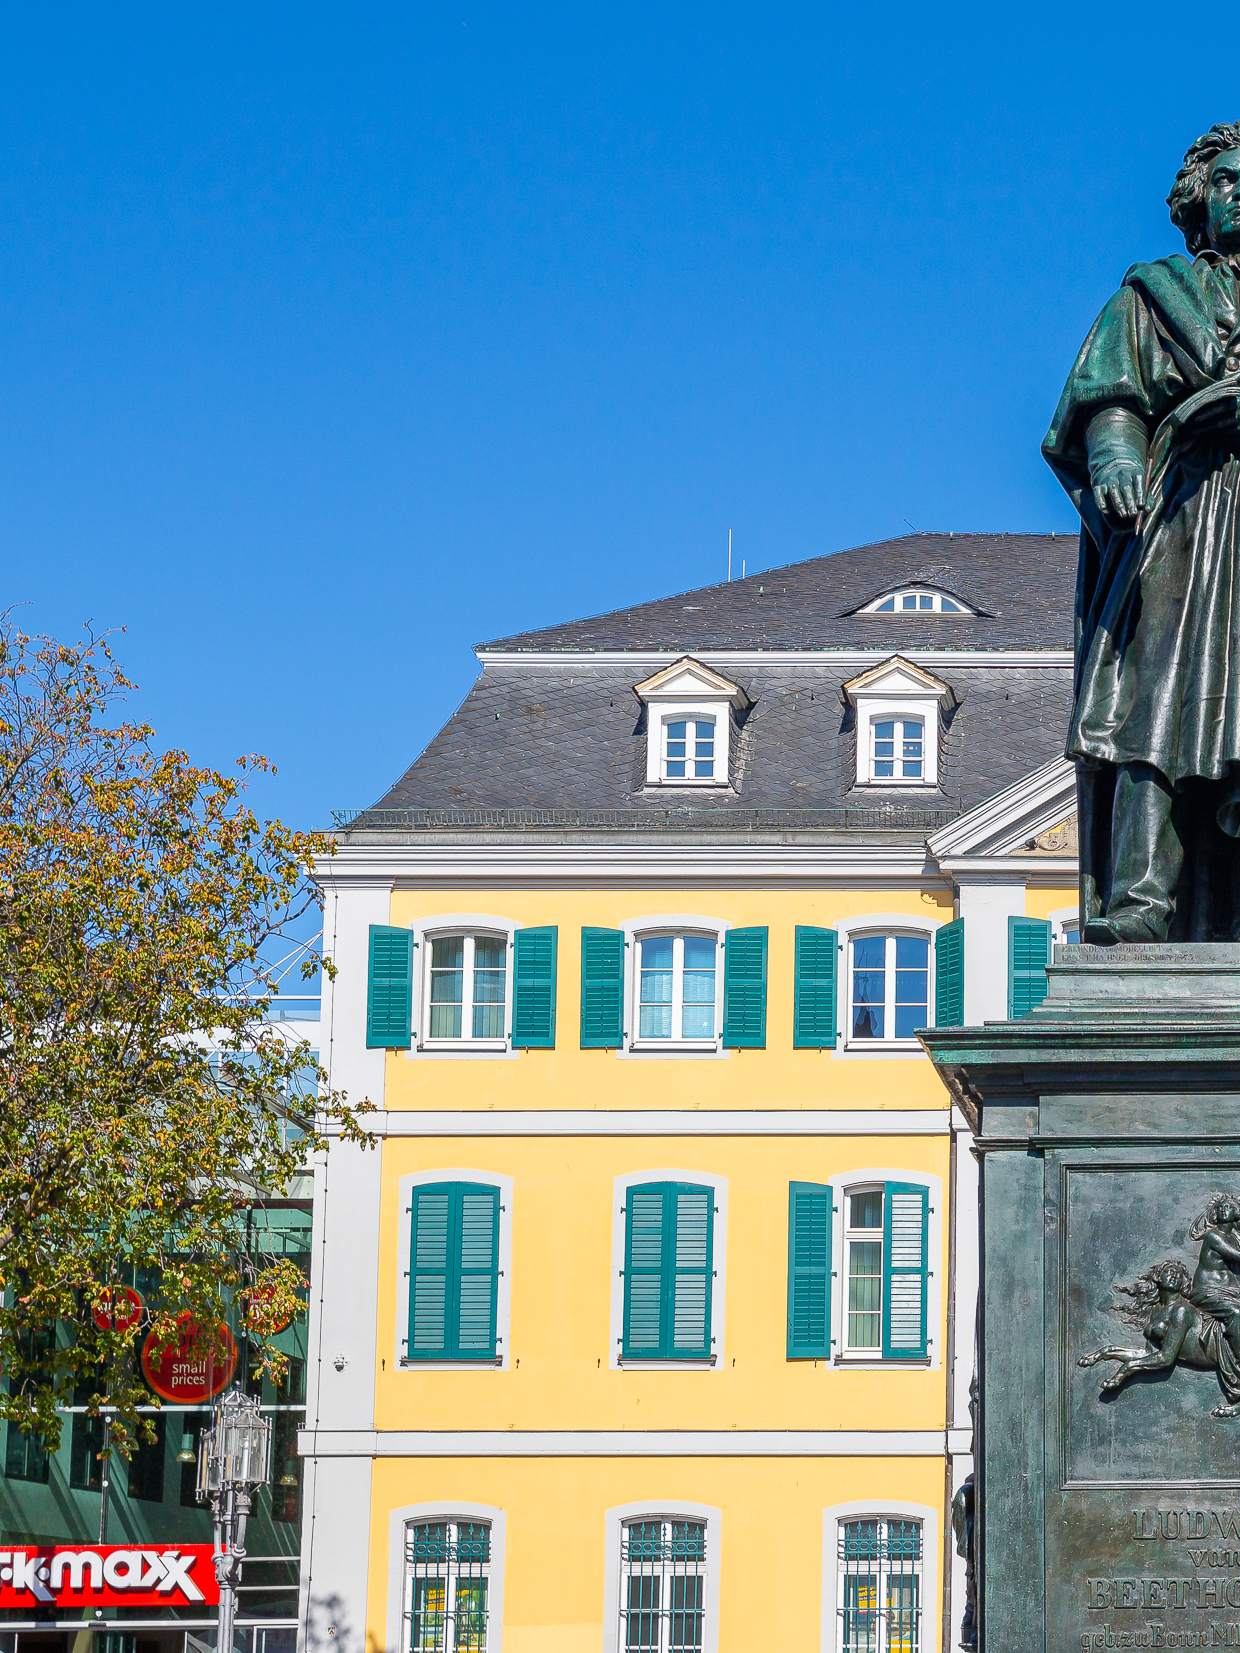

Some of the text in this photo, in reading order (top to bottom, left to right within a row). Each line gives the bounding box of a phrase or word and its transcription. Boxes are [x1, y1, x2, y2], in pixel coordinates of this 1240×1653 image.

[172, 1360, 206, 1374] small
[171, 1374, 206, 1388] prices
[1150, 1623, 1210, 1648] Bonn
